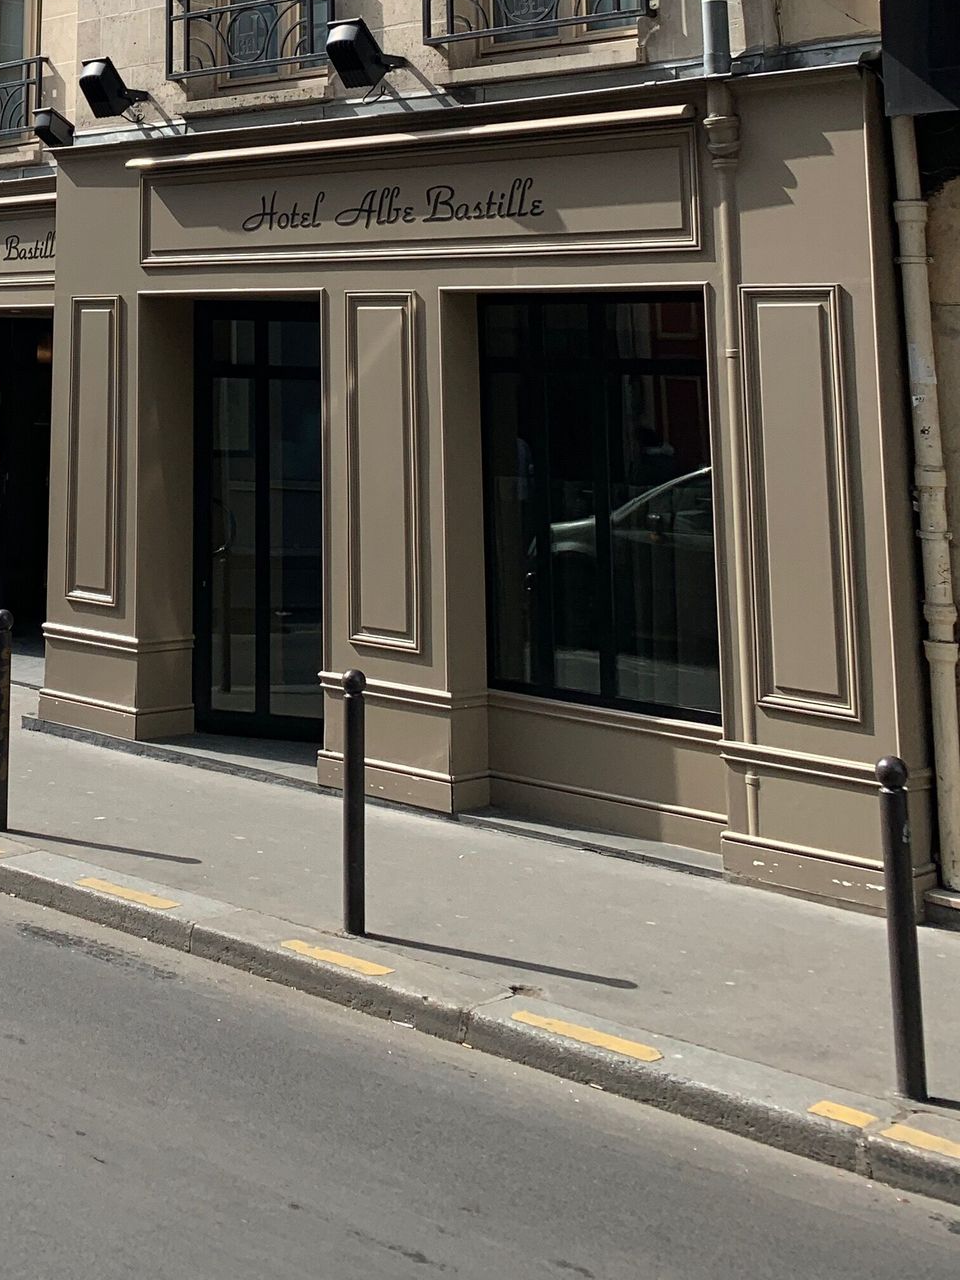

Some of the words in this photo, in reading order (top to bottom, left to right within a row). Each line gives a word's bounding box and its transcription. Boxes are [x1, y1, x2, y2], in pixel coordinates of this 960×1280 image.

[242, 191, 325, 232] Hotel
[334, 186, 417, 229] Albe
[422, 177, 544, 223] Bastille
[3, 231, 56, 261] Bastill
